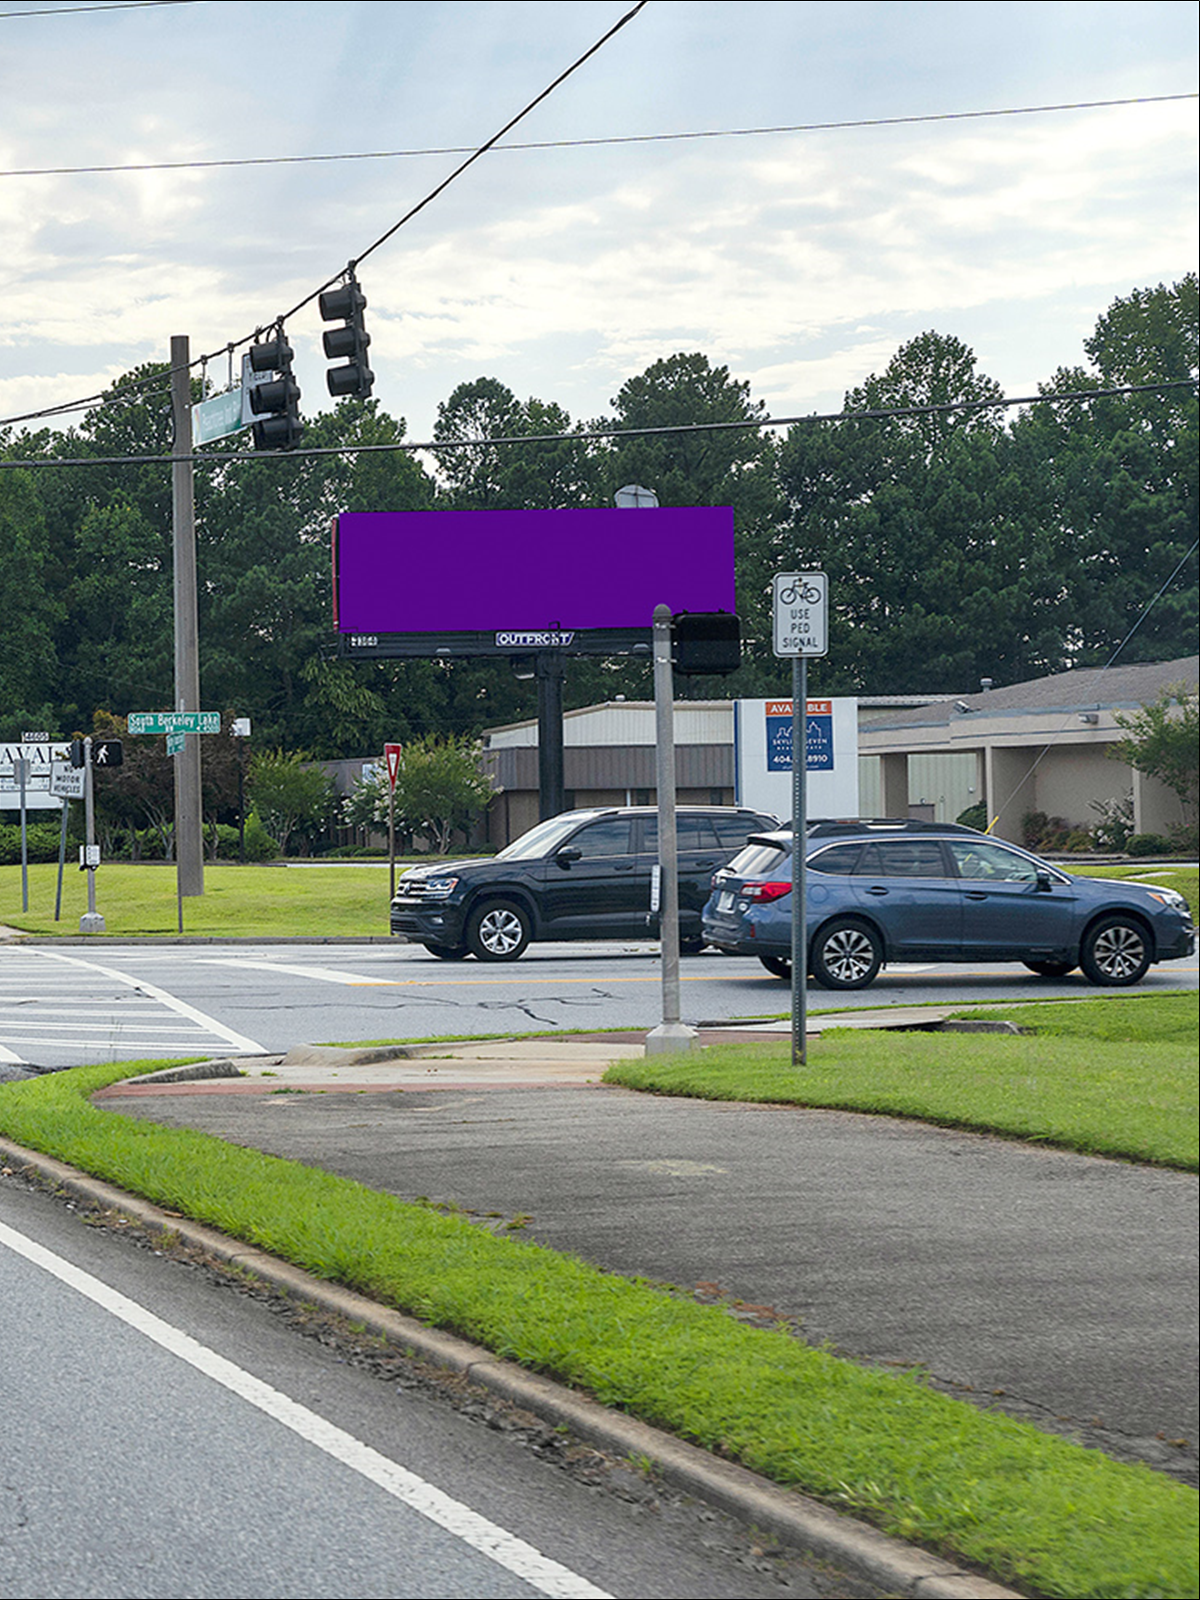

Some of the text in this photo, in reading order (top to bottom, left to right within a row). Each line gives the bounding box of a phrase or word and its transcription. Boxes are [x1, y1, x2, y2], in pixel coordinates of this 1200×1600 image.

[790, 608, 810, 620] USE
[790, 622, 810, 634] PED
[782, 637, 818, 649] SIGNAL
[770, 703, 828, 713] AVABLE
[130, 712, 218, 728] South Berkeley Lake
[56, 775, 80, 784] MOTOR
[53, 785, 80, 794] VEHICLES
